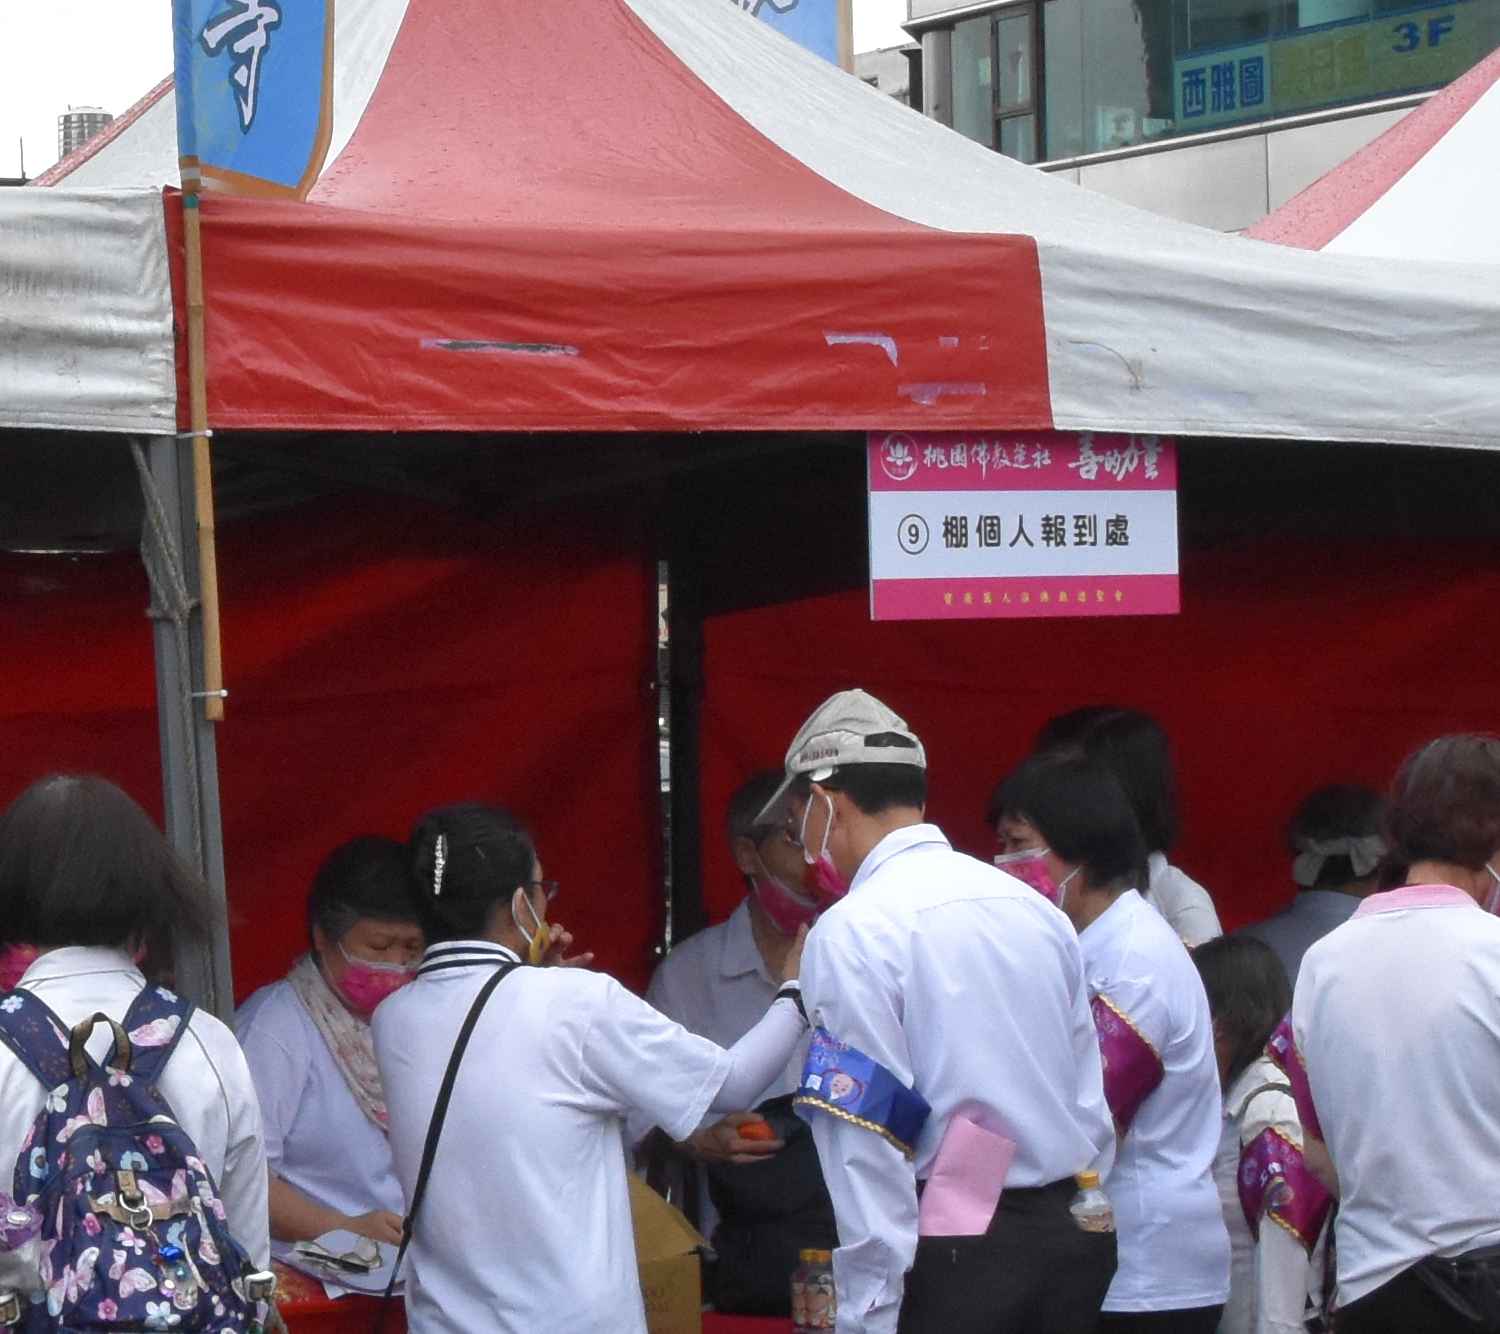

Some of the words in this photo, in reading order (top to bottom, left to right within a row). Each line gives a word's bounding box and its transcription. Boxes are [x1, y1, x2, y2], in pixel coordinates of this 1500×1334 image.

[1392, 14, 1456, 54] 3F
[922, 439, 1052, 479] 桃園佛教蓮社
[942, 514, 1130, 549] 棚個人報到處
